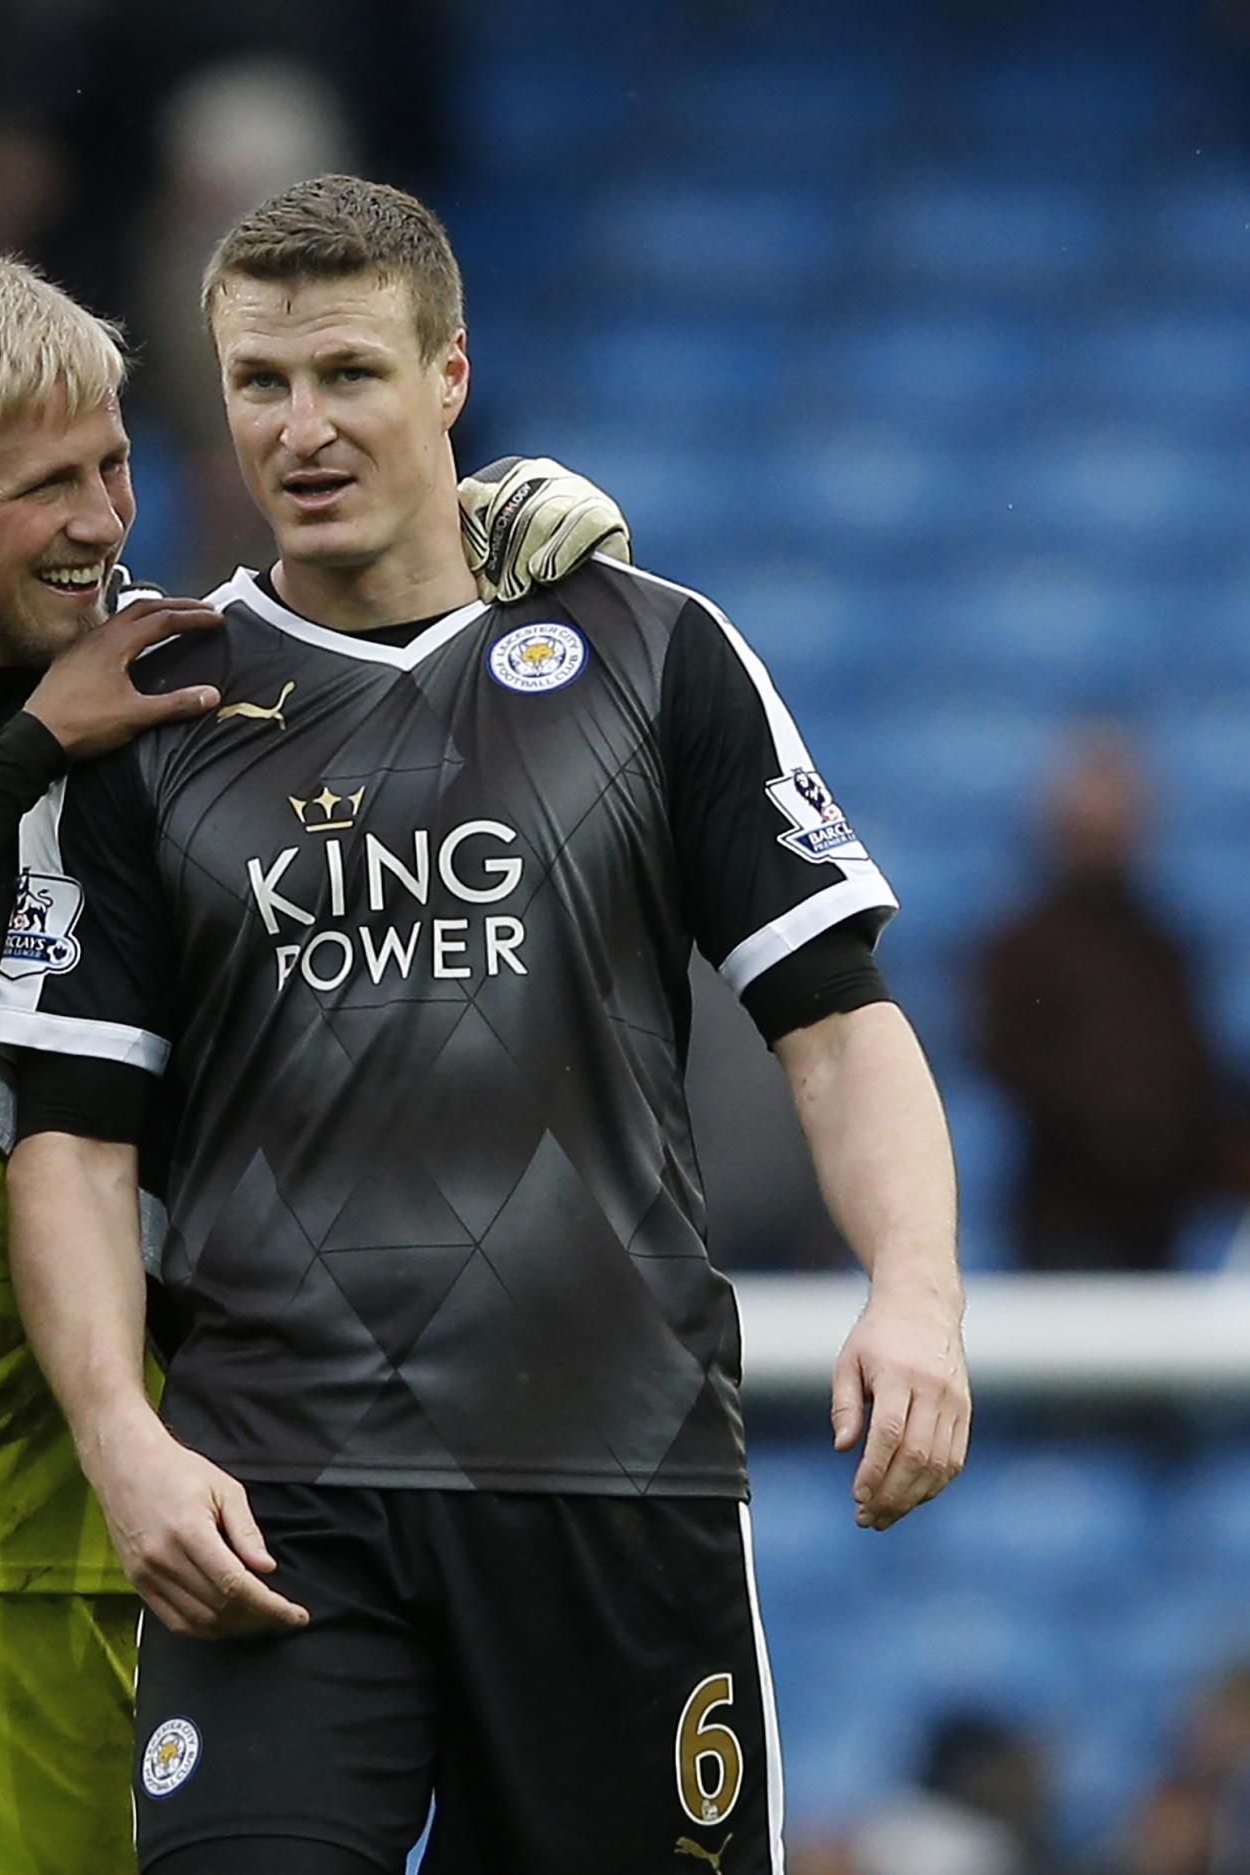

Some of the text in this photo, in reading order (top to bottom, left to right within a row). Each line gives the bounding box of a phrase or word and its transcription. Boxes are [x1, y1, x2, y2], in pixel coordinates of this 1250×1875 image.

[247, 819, 524, 936] KING
[807, 821, 853, 844] BARCL
[274, 915, 529, 993] POWER
[674, 1672, 743, 1826] 6
